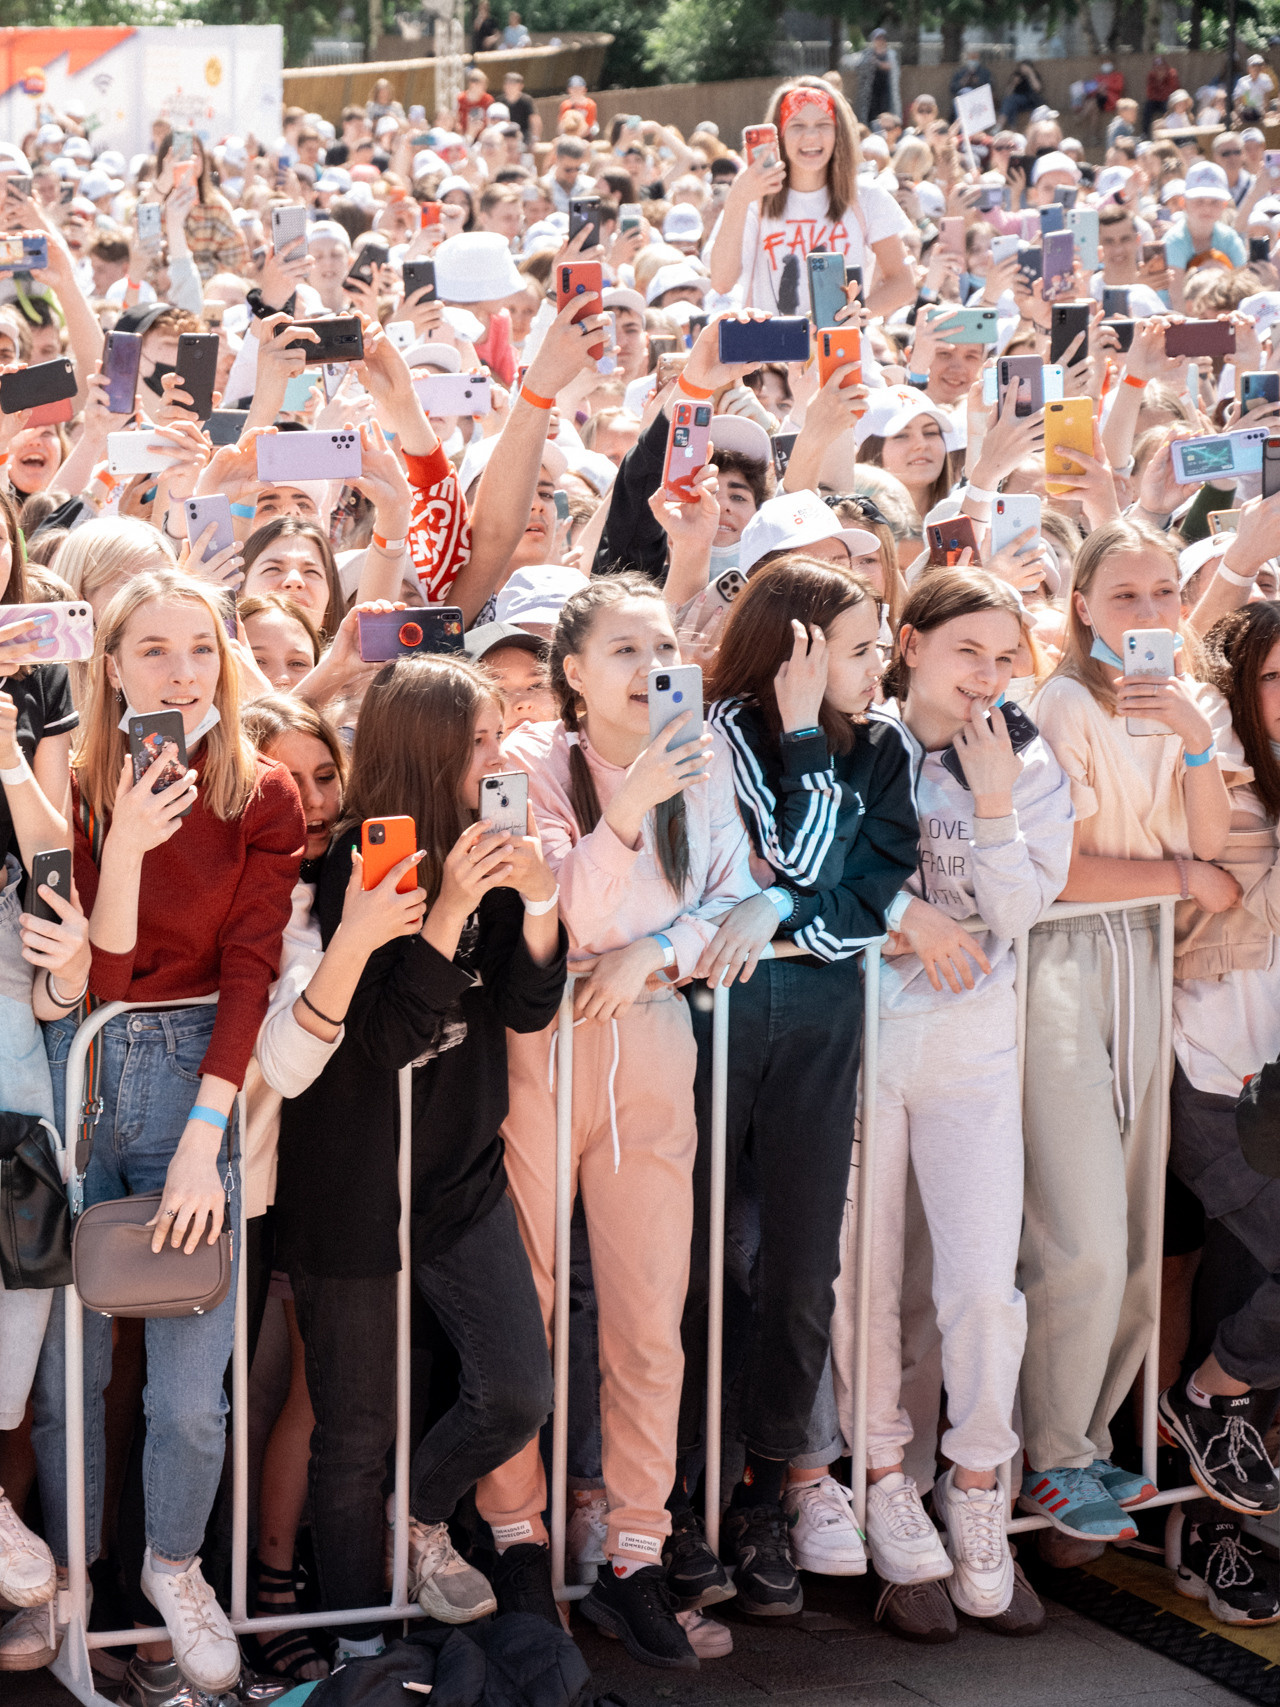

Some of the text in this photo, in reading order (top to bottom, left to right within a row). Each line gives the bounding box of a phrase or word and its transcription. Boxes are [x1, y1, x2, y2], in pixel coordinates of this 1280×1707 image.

[926, 818, 970, 840] OVE
[920, 849, 965, 877] FFAIR
[1230, 1398, 1250, 1407] JXYU
